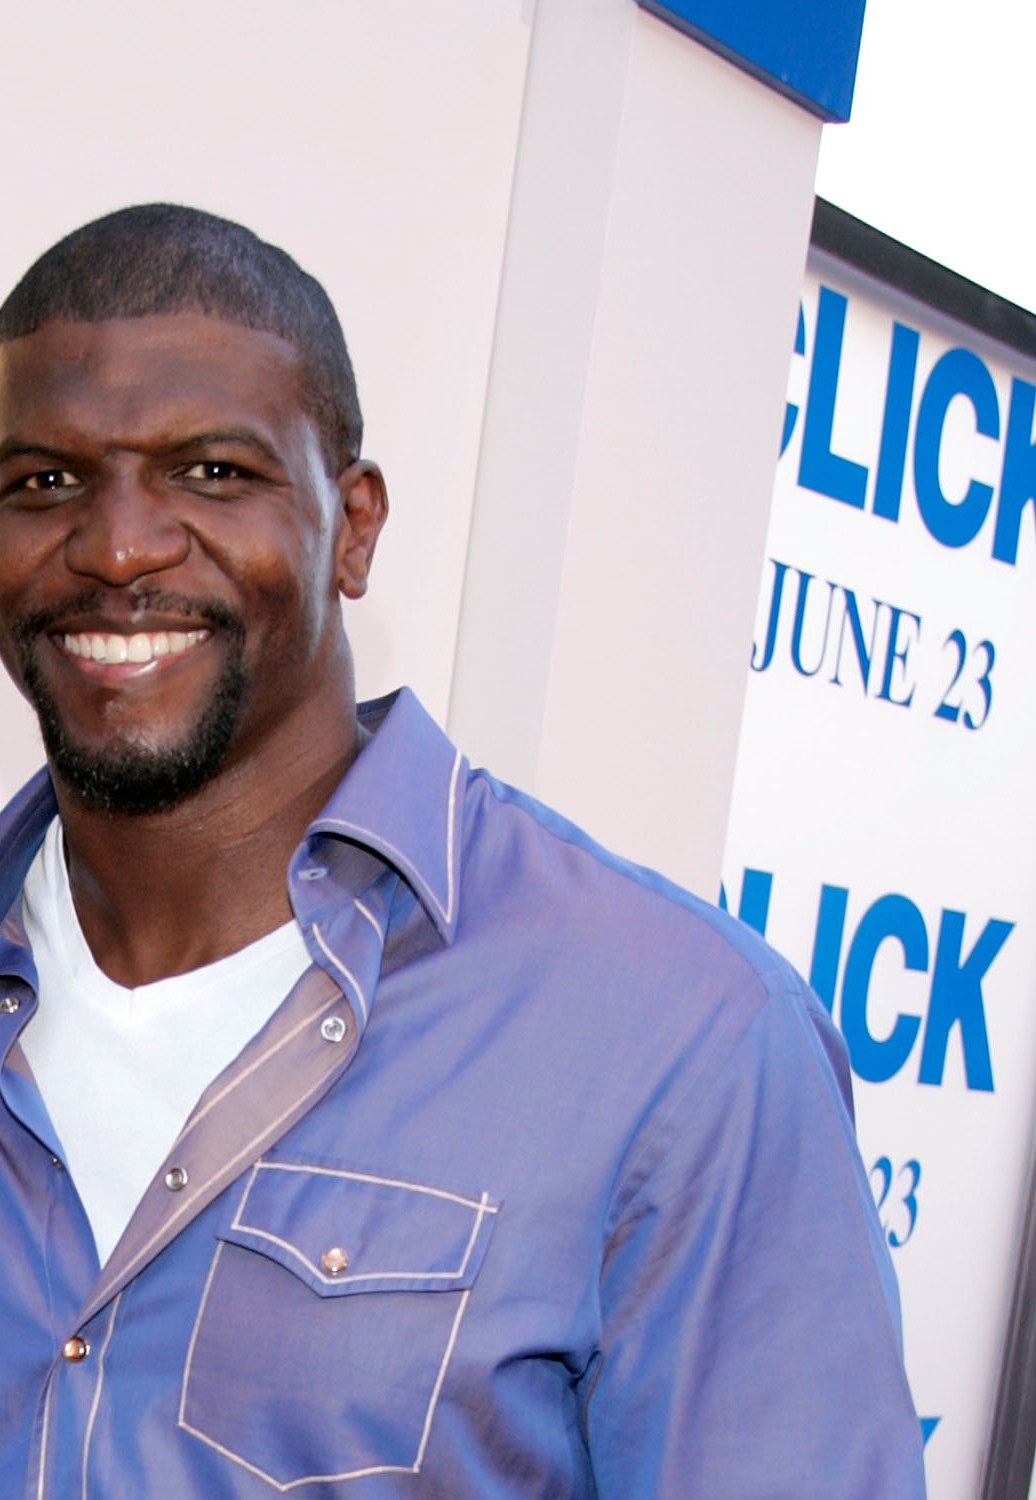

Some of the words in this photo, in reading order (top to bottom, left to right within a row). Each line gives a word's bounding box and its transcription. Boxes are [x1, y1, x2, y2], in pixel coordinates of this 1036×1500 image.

[779, 284, 1036, 566] LICK
[751, 557, 921, 708] JUNE
[933, 628, 996, 731] 23
[719, 866, 1017, 1093] ICK
